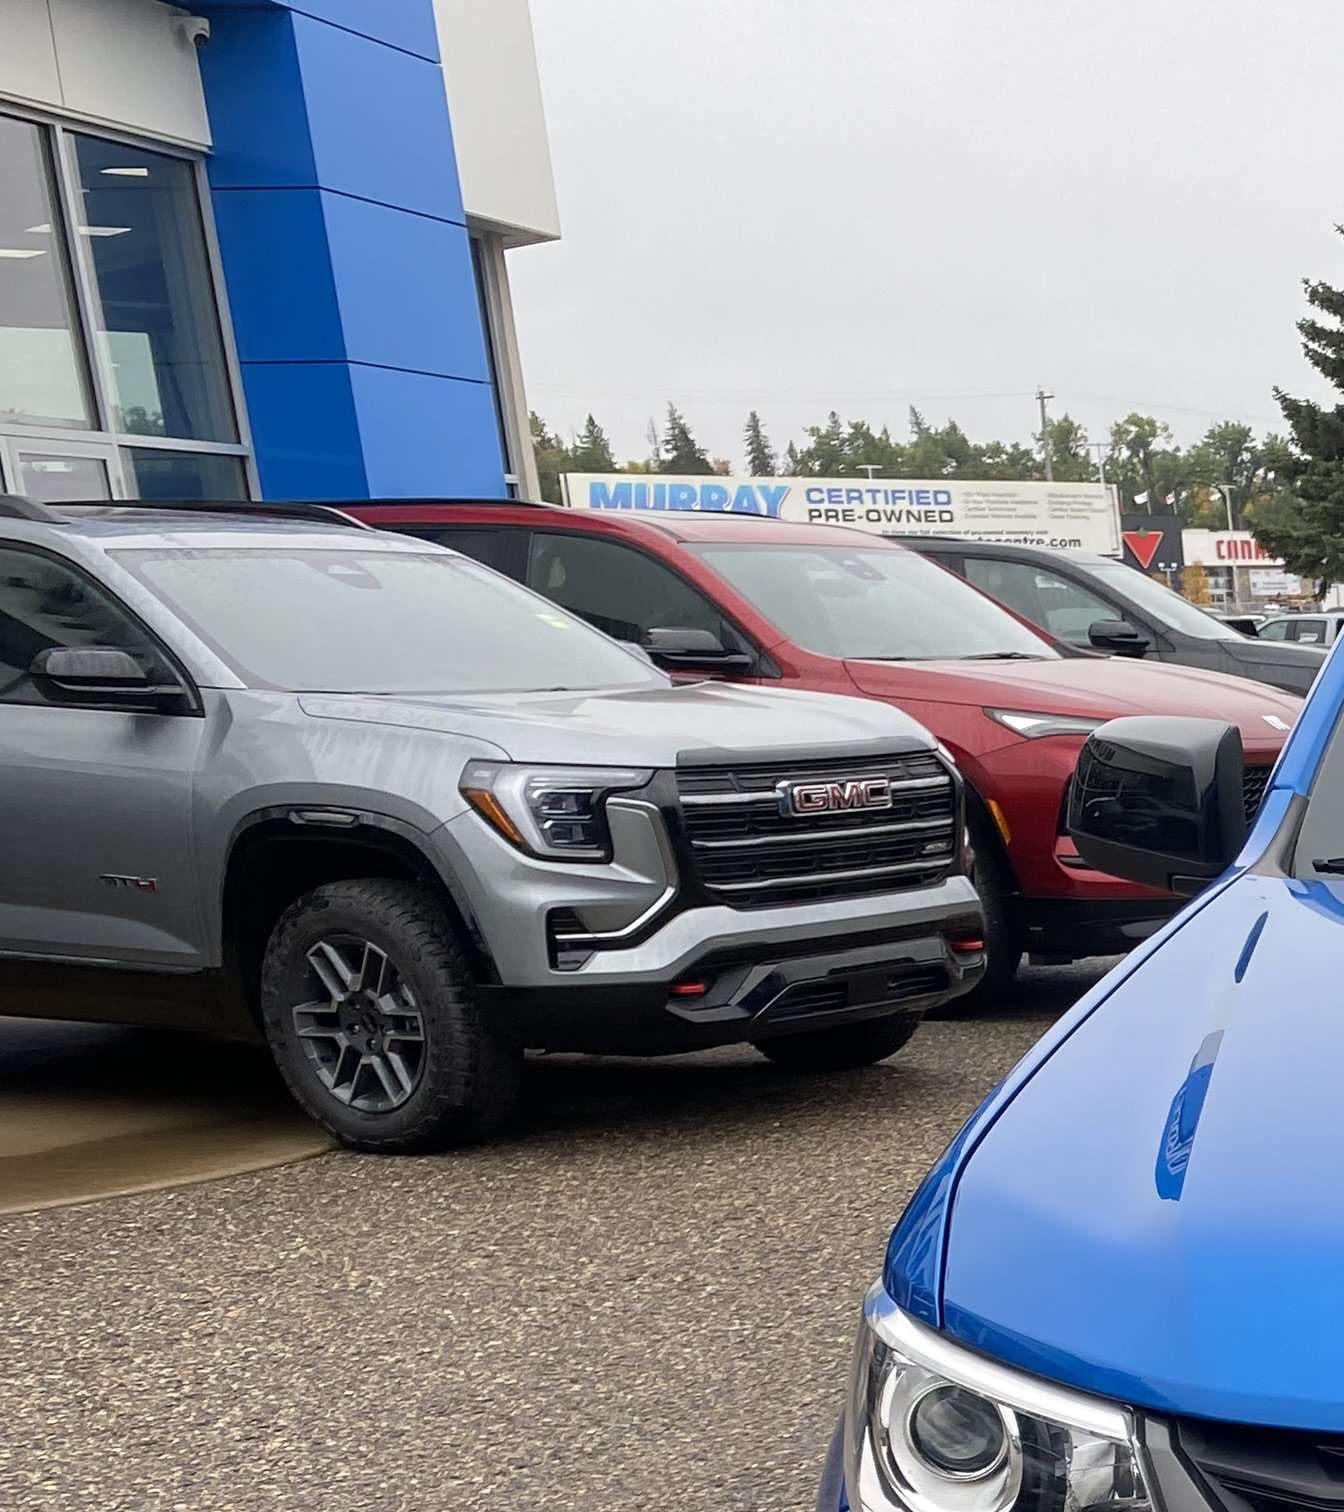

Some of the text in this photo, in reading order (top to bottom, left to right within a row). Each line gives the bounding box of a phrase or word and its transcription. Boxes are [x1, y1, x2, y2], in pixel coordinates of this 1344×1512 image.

[589, 482, 791, 518] MURRAY
[805, 488, 951, 506] CERTIFIED
[808, 508, 954, 523] PRE-OWNED
[794, 779, 891, 813] GMC
